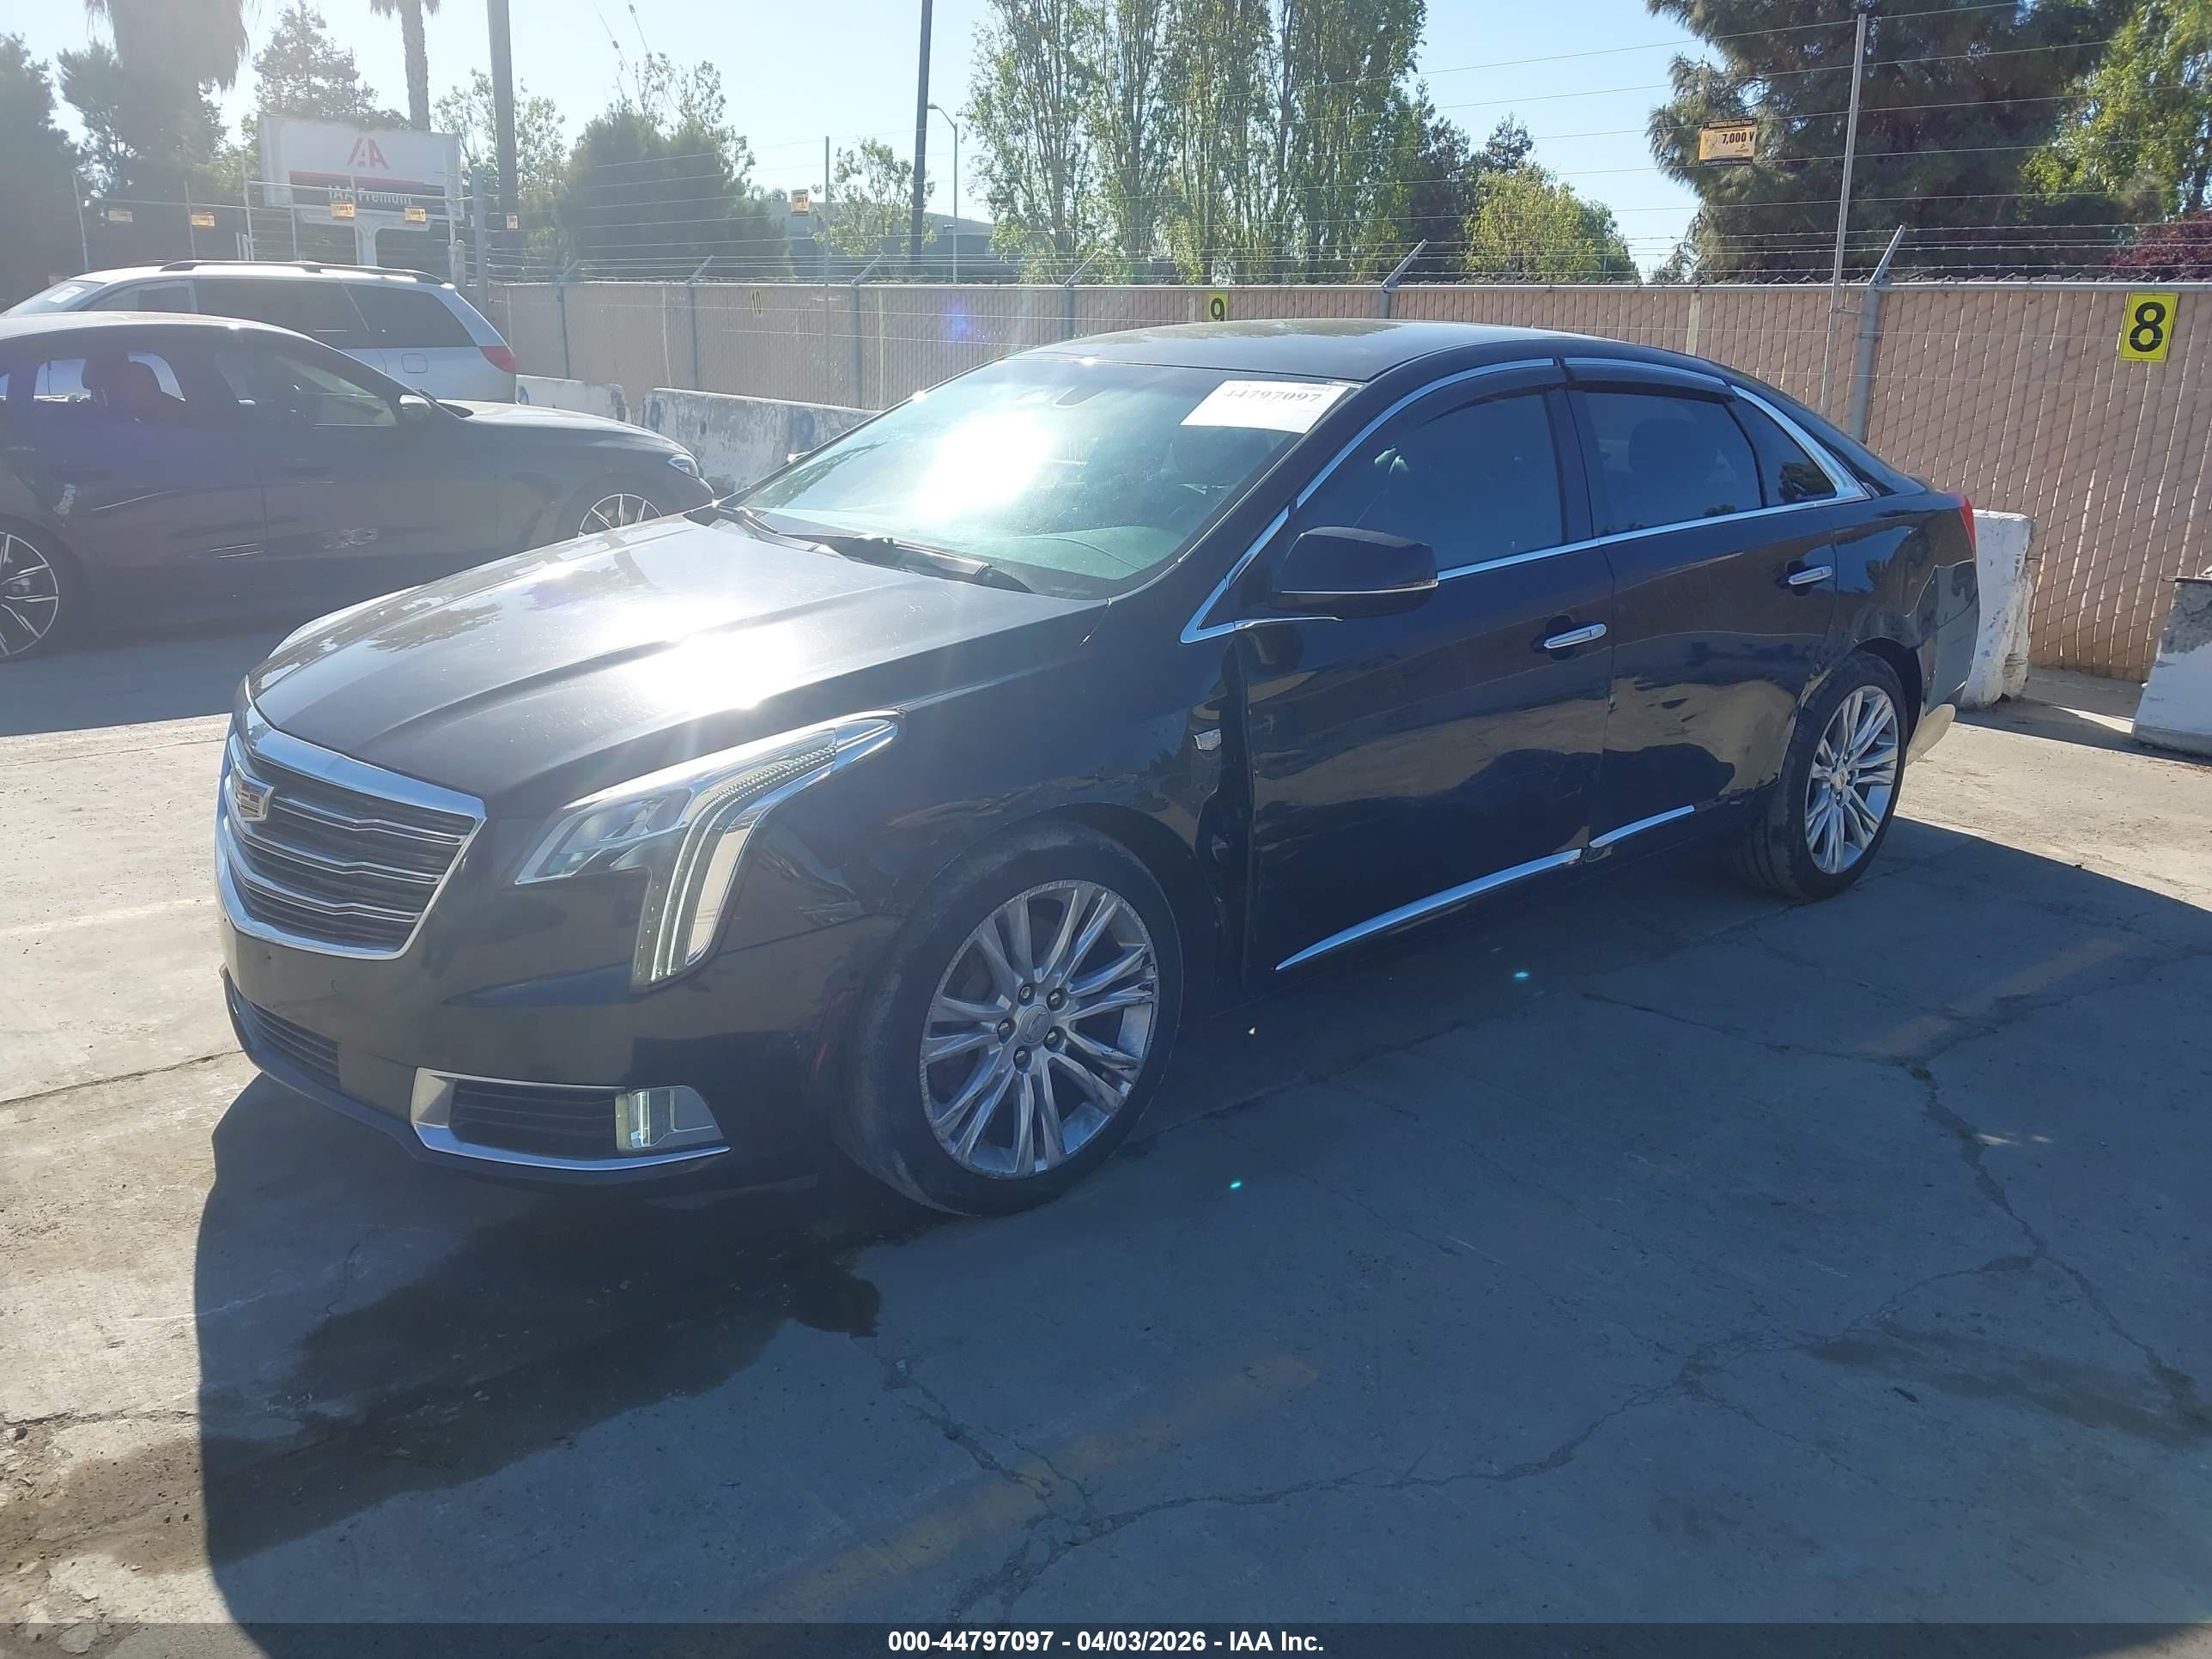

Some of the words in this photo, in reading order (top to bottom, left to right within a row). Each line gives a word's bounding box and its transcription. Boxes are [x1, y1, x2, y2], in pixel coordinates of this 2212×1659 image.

[1722, 132, 1747, 145] 7,000
[1749, 131, 1755, 142] V
[1210, 297, 1225, 321] 9
[2130, 301, 2166, 352] 8
